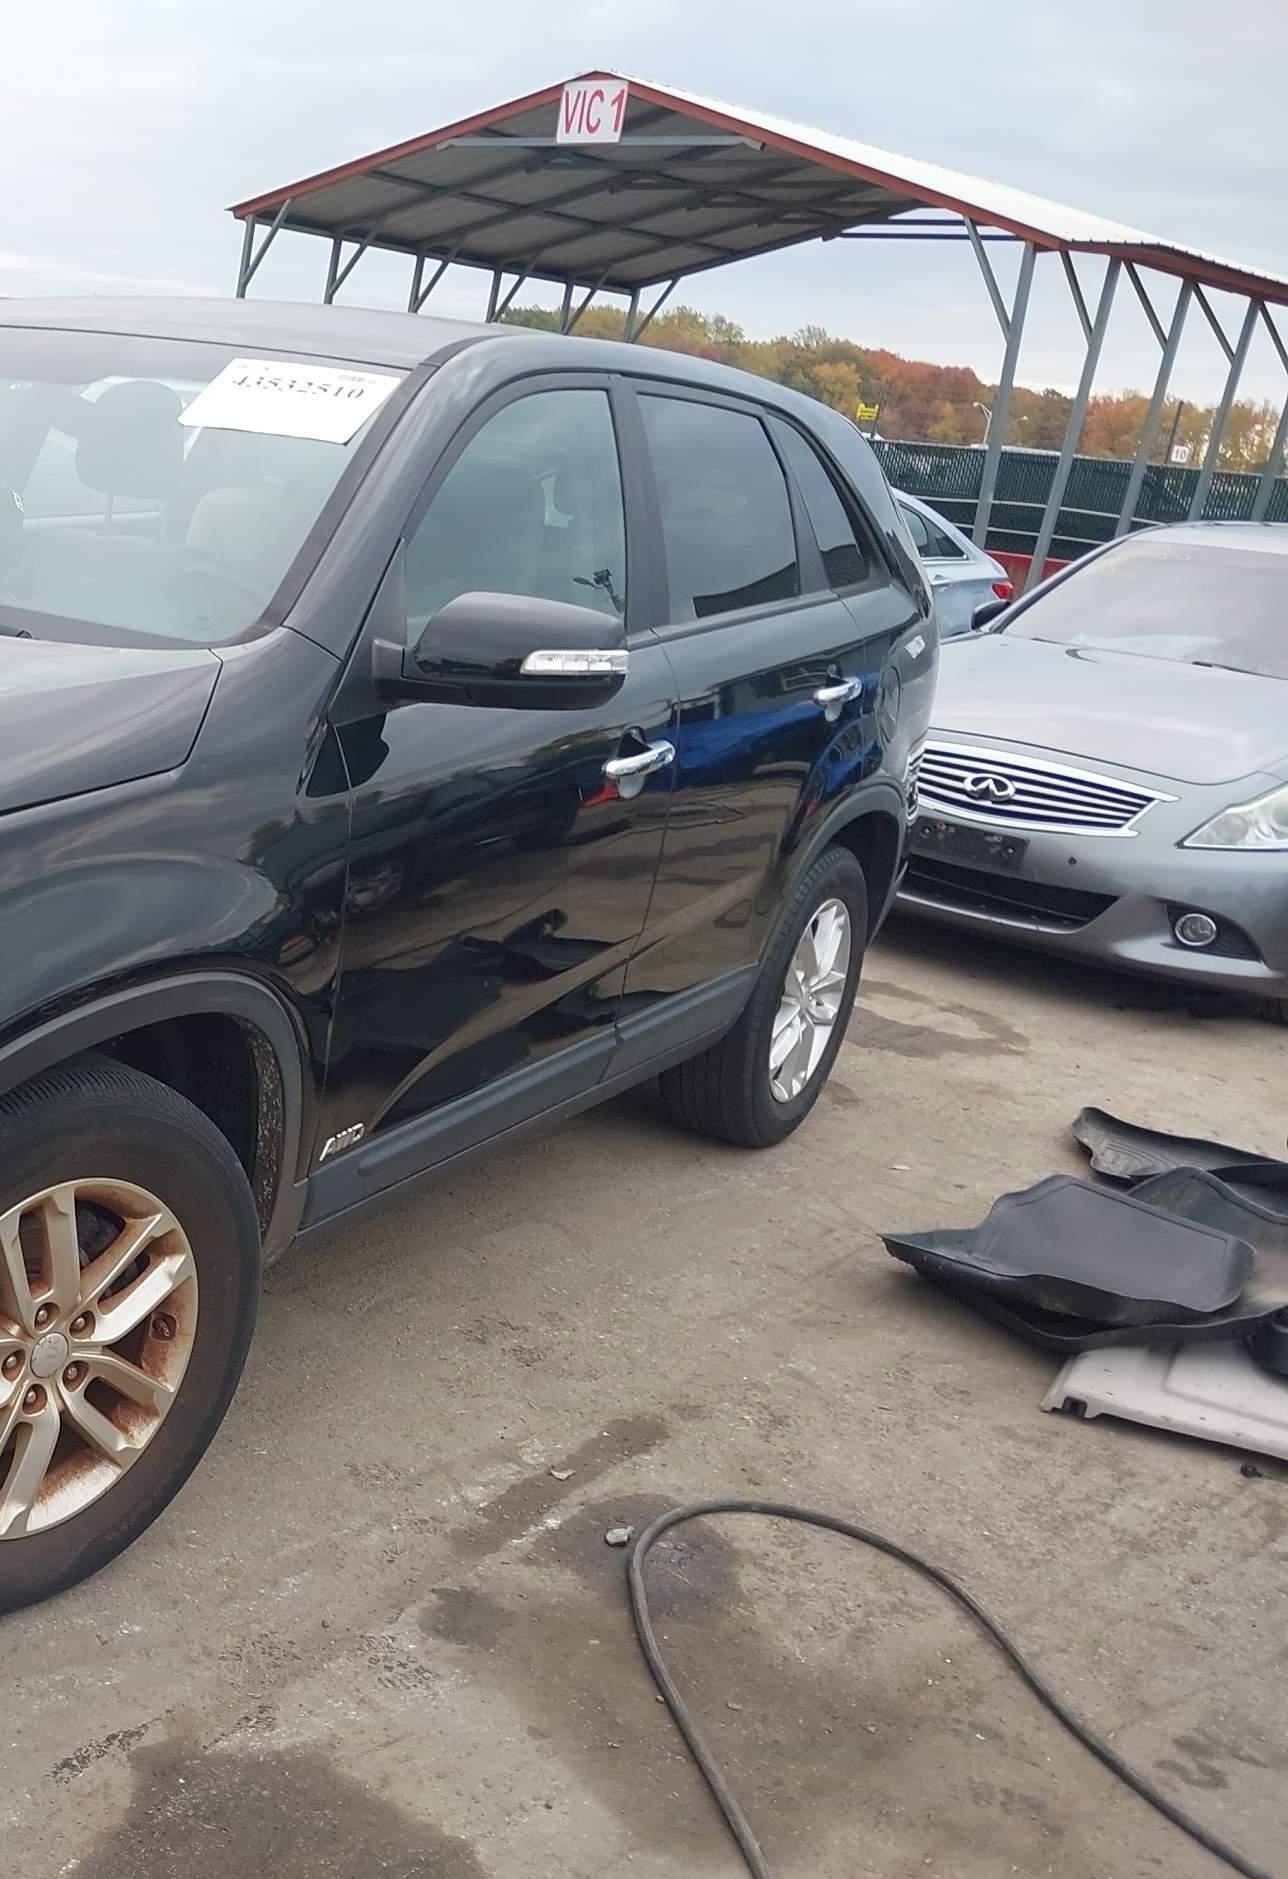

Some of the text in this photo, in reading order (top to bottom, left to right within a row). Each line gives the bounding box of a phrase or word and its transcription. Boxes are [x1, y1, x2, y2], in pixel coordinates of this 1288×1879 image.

[564, 88, 626, 134] VIC 1
[1174, 448, 1187, 460] 10
